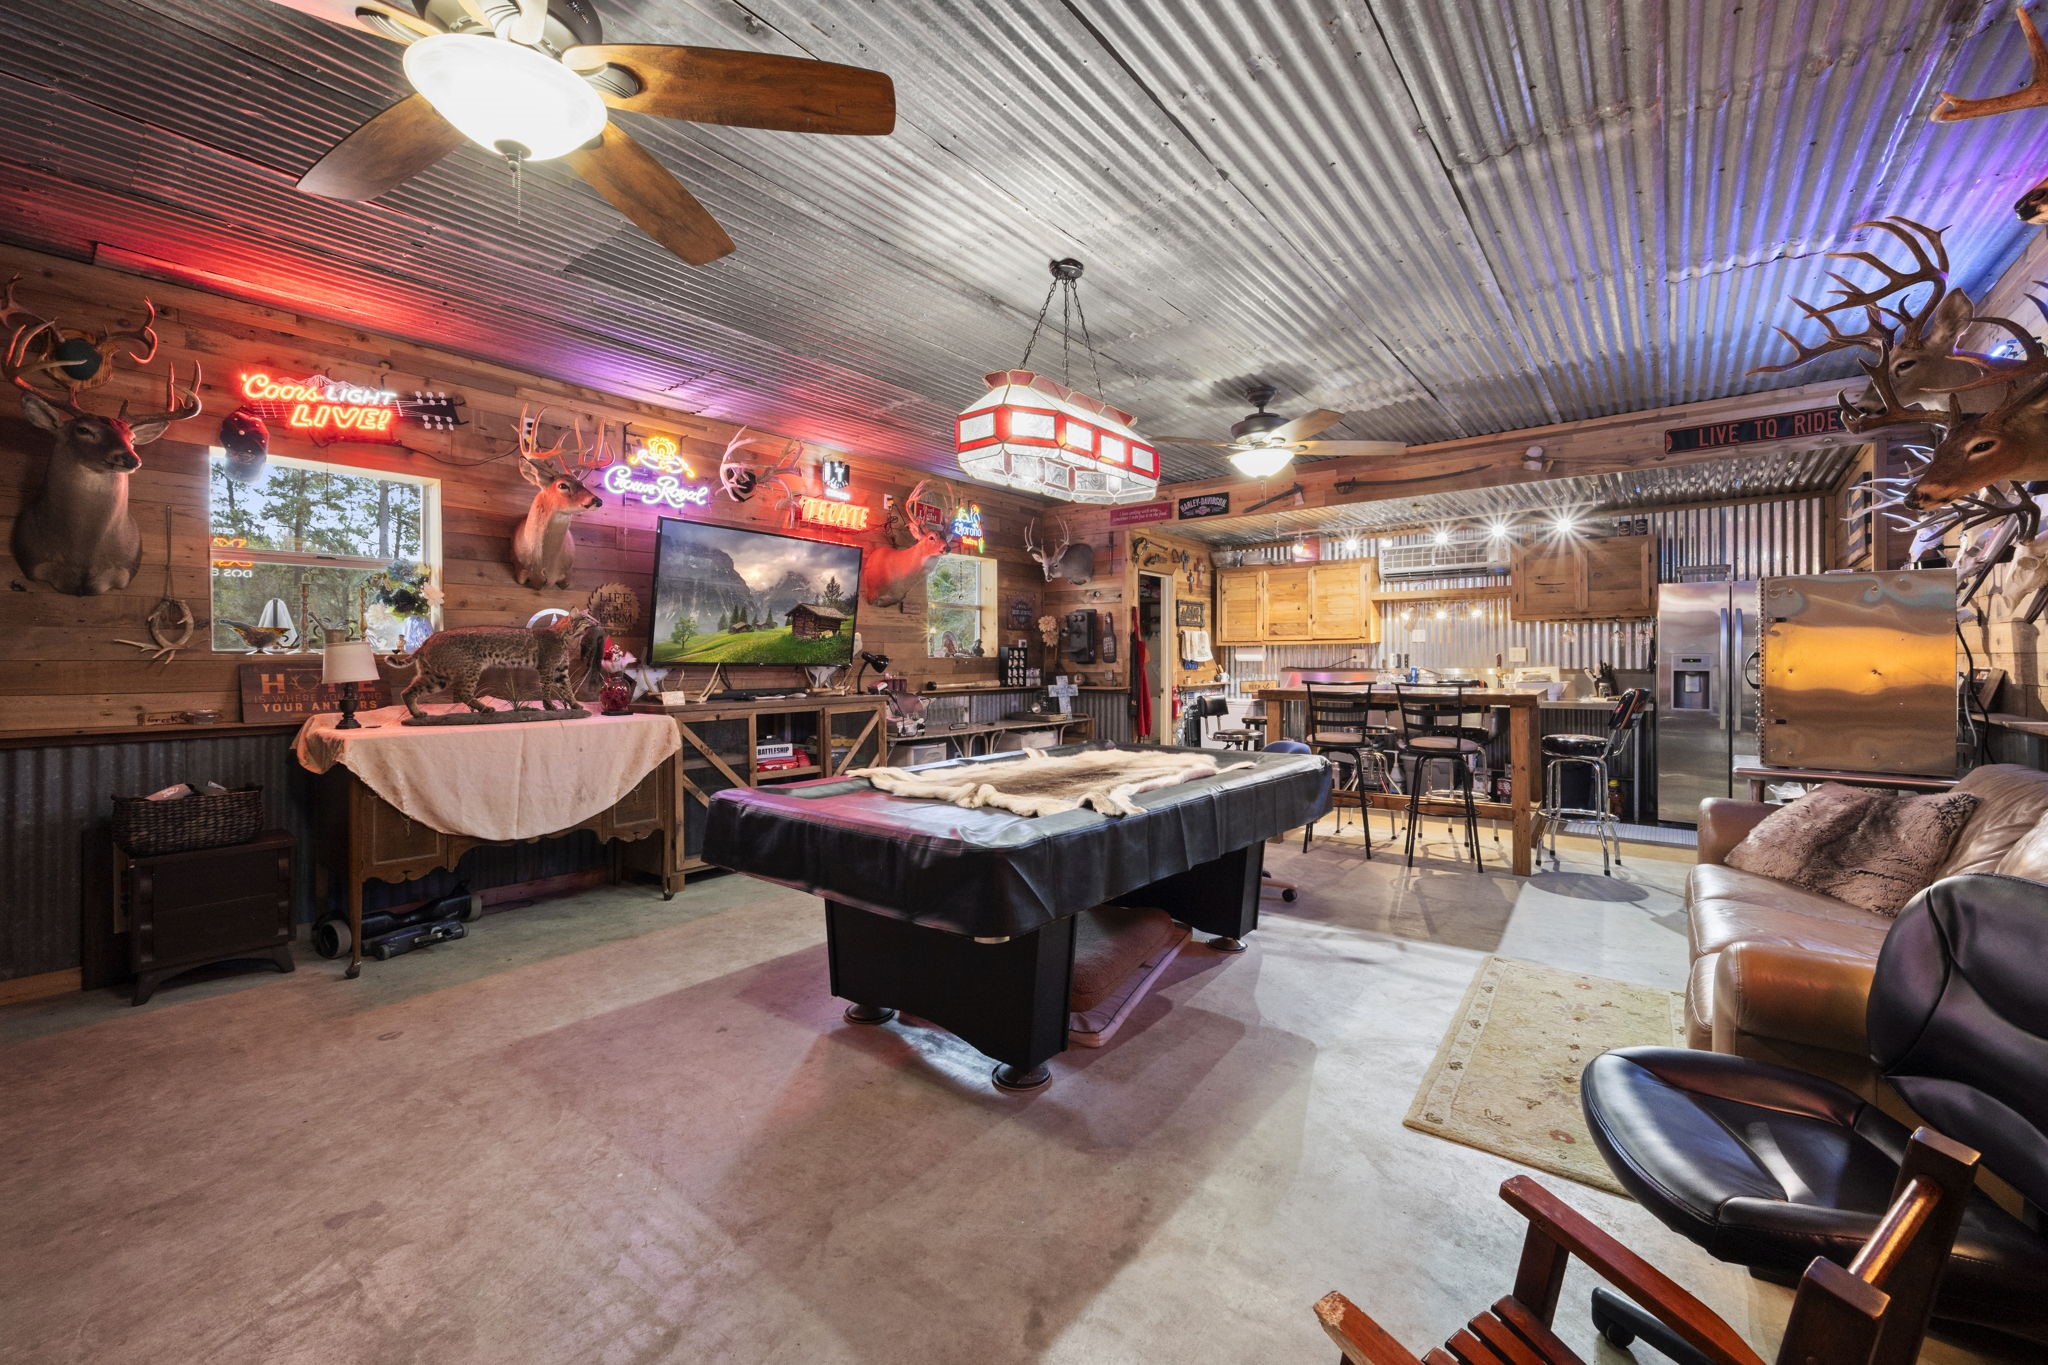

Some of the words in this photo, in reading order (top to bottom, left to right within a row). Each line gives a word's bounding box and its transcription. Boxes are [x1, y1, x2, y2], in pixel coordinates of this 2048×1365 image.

[242, 374, 324, 401] Coors
[326, 385, 397, 405] LIGHT
[291, 404, 393, 430] LIVE!
[1699, 423, 1740, 447] LIVE
[1754, 418, 1778, 439] TO
[1793, 410, 1839, 434] RIDE
[604, 465, 657, 494] Crown
[641, 475, 709, 508] Royal
[804, 498, 870, 528] TECATE
[262, 702, 304, 713] YOUR
[312, 700, 377, 711] ANTRS
[758, 747, 789, 755] BATTLESHIP
